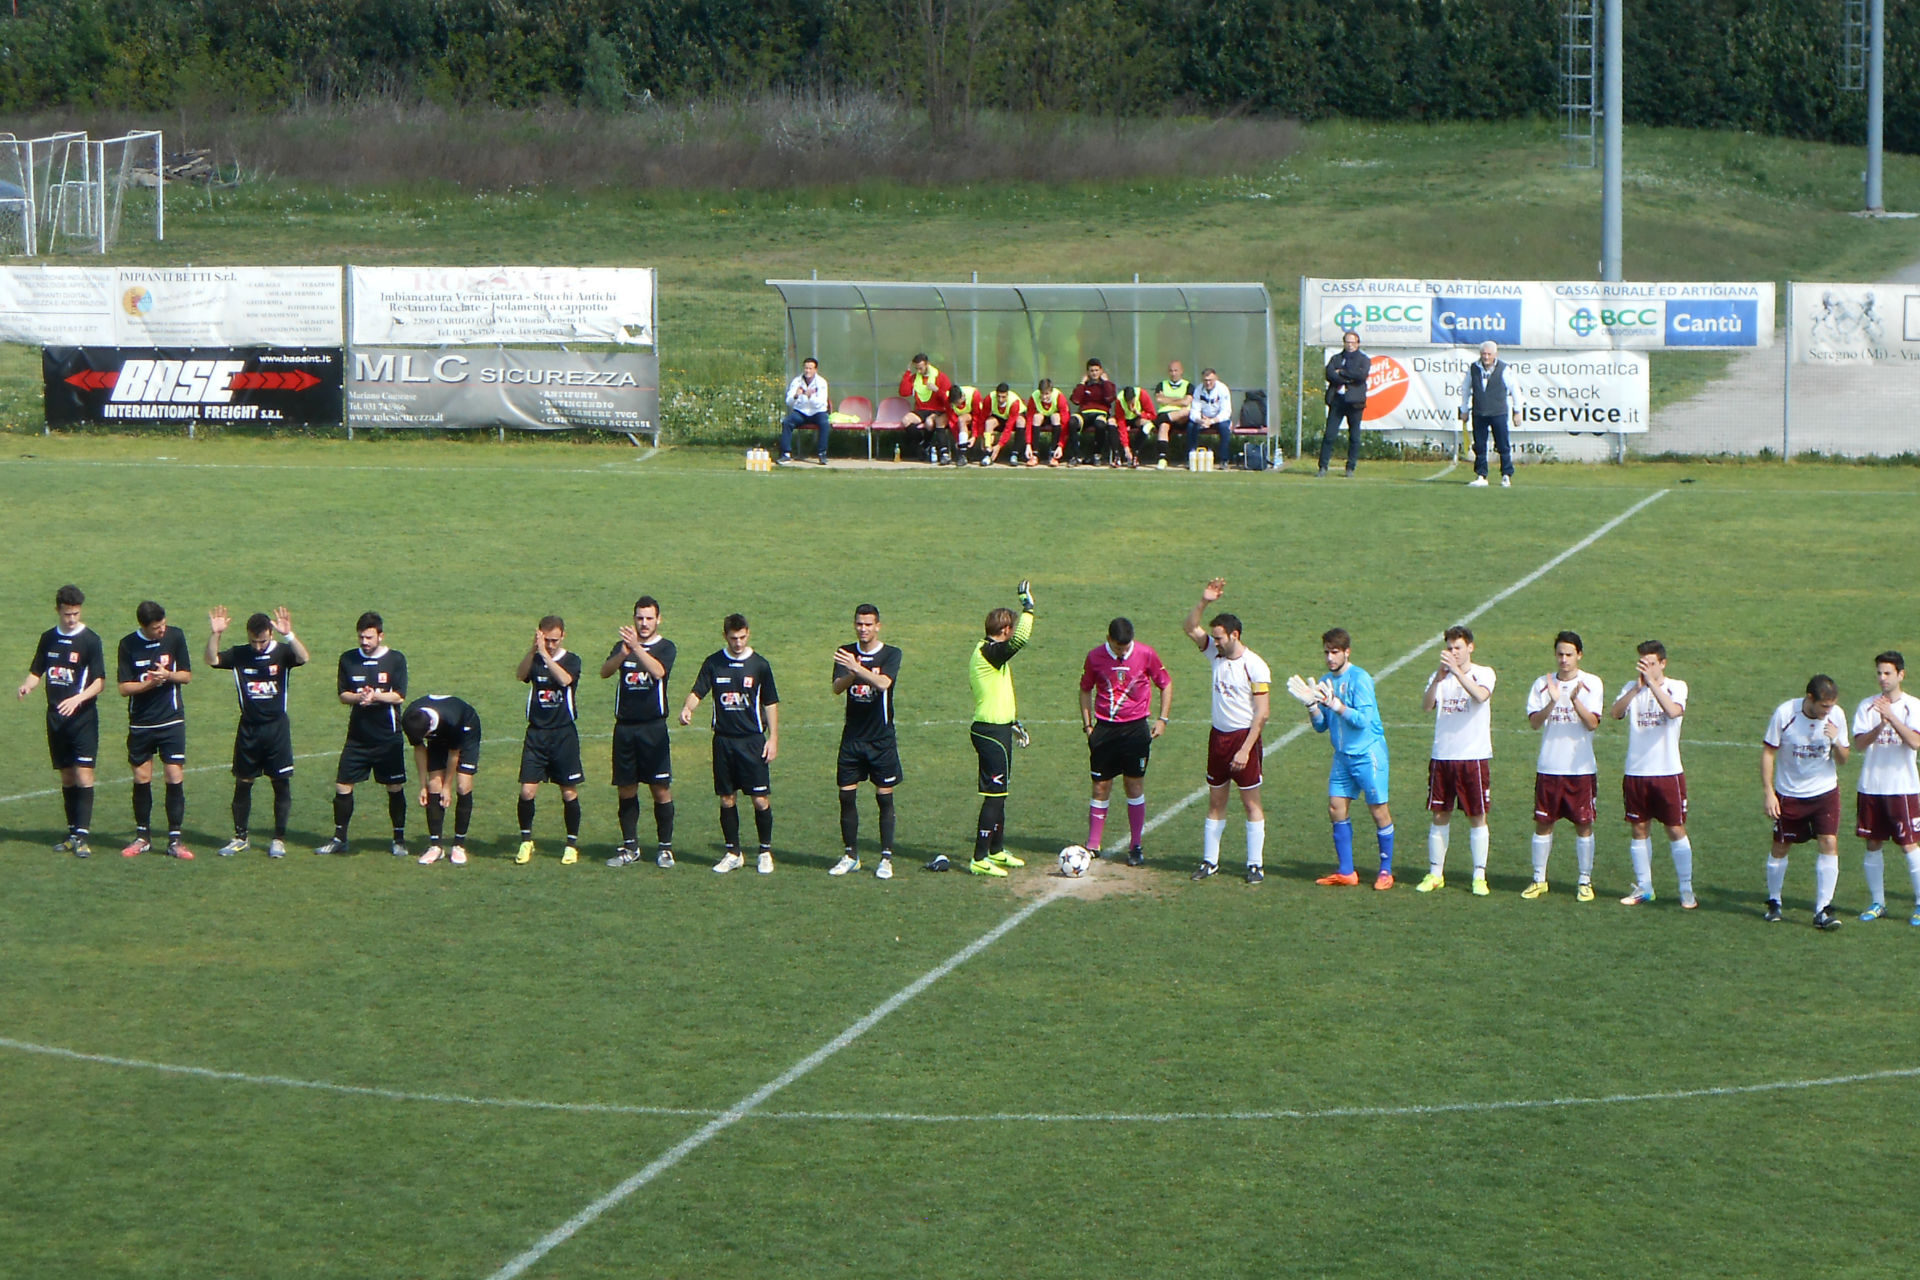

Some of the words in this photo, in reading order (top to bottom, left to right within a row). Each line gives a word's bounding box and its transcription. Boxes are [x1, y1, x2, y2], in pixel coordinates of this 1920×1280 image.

[120, 271, 173, 282] IMPIANTI
[175, 271, 211, 282] BETTI
[214, 272, 237, 282] S.r.l.
[1321, 282, 1365, 293] CASSA
[1368, 282, 1421, 294] RURALE
[1425, 283, 1443, 294] ED
[1447, 284, 1523, 296] ARTIGIANA
[1555, 285, 1600, 297] CASSA
[1603, 285, 1655, 297] RURALE
[1659, 285, 1677, 297] ED
[1681, 285, 1759, 297] ARTIGIANA
[380, 291, 452, 302] Imbiancatura
[455, 291, 523, 302] Verniciatura
[534, 291, 573, 302] Stucchi
[577, 291, 616, 302] Antichi
[389, 302, 437, 312] Restauro
[559, 302, 609, 315] cappotto
[1365, 305, 1424, 322] BCC
[1439, 311, 1506, 331] Cantù
[1600, 308, 1657, 326] BCC
[1673, 313, 1742, 333] Cantù
[1809, 348, 1858, 361] Seregno
[355, 353, 470, 383] MLC
[480, 366, 640, 388] SICUREZZA
[1538, 360, 1639, 376] automatica
[110, 360, 246, 402] BASE
[544, 390, 598, 400] ANTIFURTI
[1530, 386, 1541, 399] e
[1547, 383, 1601, 400] snack
[545, 399, 615, 409] ANTINCENDIO
[104, 404, 200, 419] INTERNATIONAL
[205, 405, 260, 419] FREIGHT
[260, 409, 284, 419] S.R.L.
[547, 417, 607, 426] CONTROLLO
